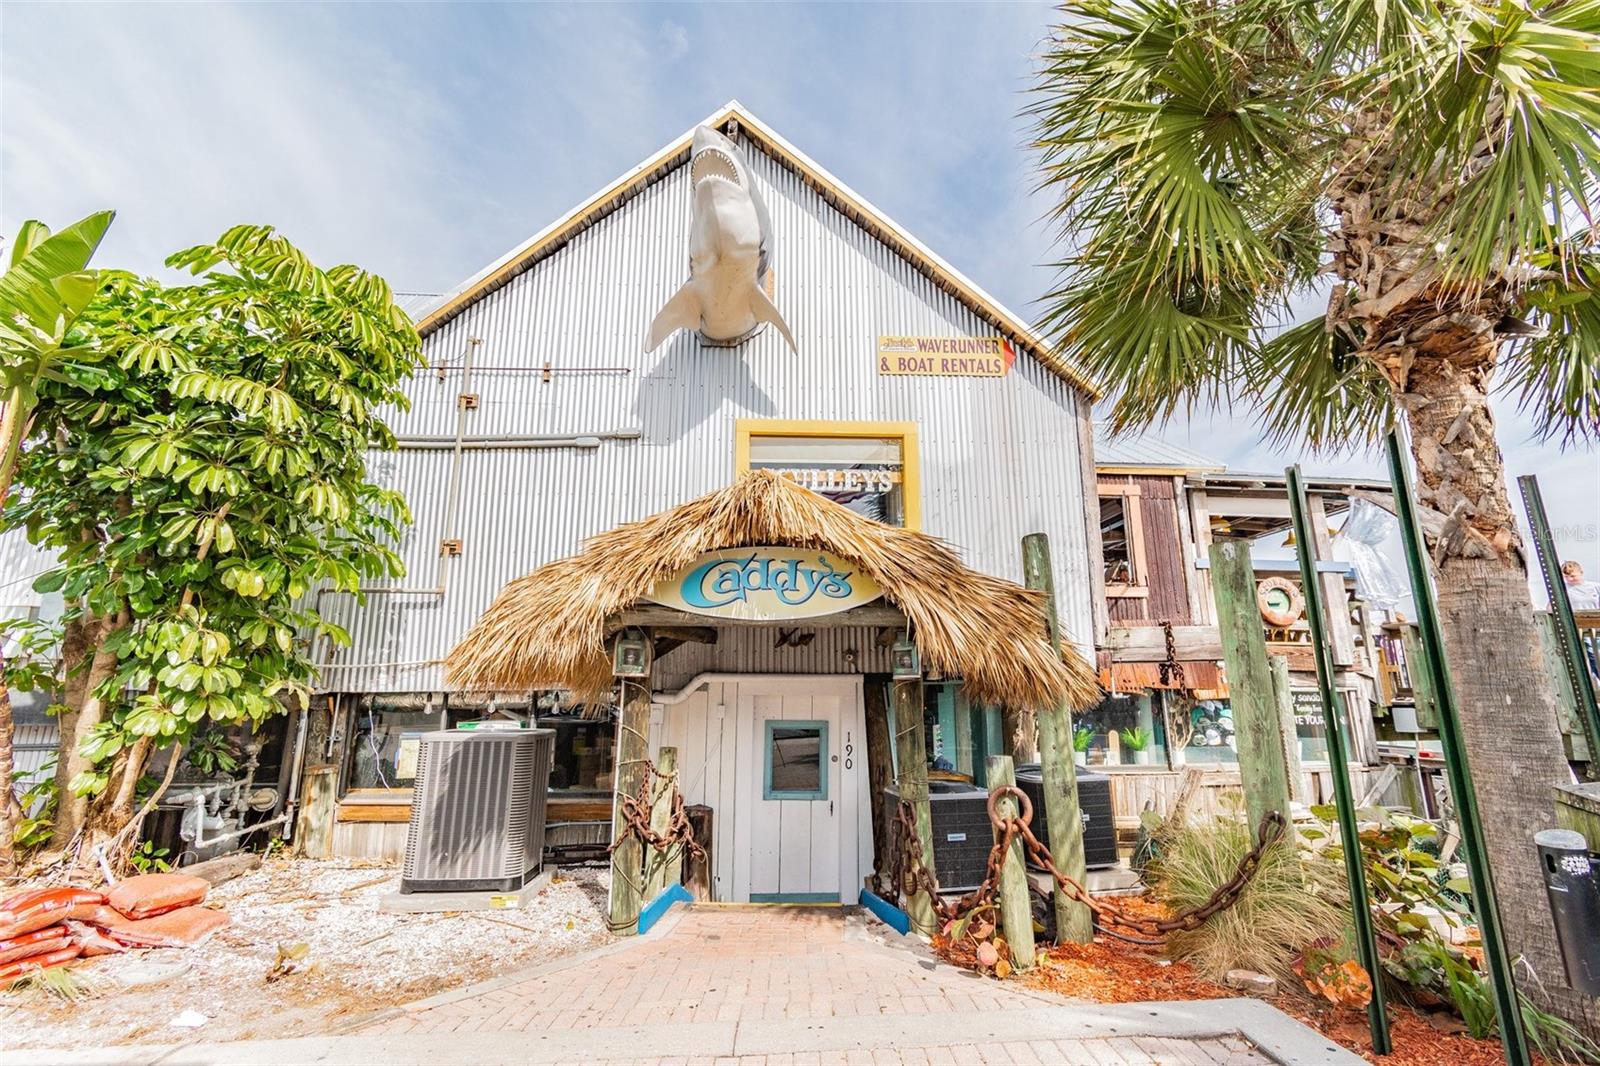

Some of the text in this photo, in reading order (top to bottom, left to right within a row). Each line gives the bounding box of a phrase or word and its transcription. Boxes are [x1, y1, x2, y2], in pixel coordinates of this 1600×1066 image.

[917, 338, 1000, 354] WAVERUNNER
[880, 357, 1001, 374] & BOAT RENTALS
[780, 469, 893, 492] ULLEYS
[679, 552, 853, 608] Caddy's
[845, 731, 853, 770] 190
